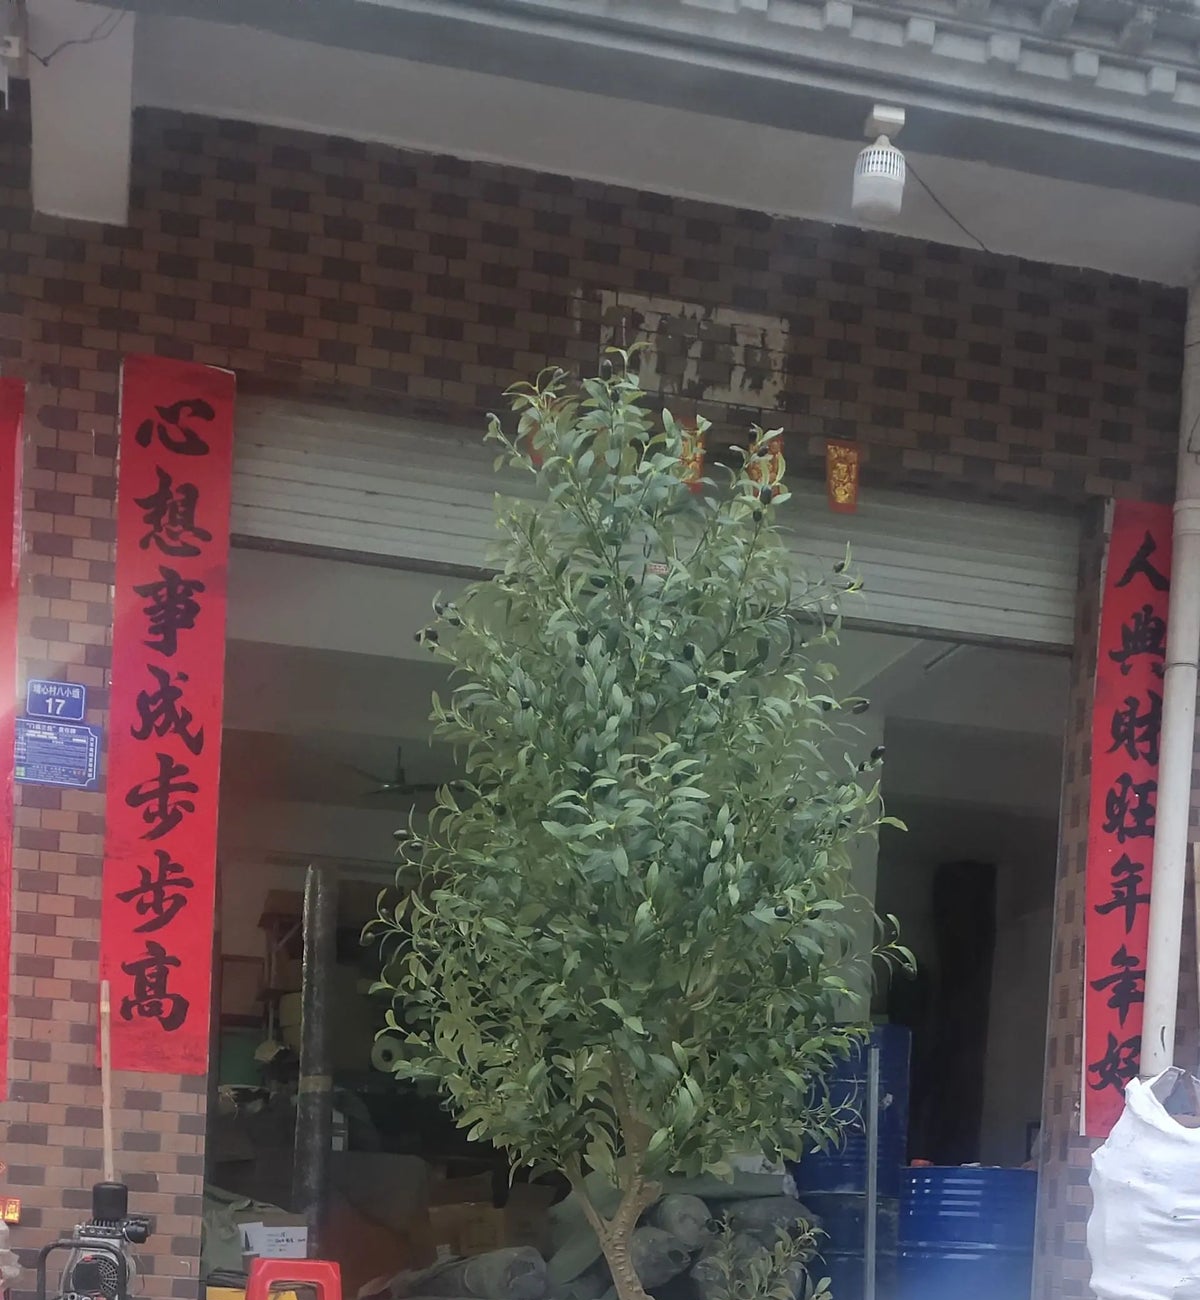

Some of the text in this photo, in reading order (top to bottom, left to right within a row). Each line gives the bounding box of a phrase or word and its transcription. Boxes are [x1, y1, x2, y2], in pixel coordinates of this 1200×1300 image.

[45, 697, 66, 714] 17
[115, 398, 215, 1032] 心想事成步步高
